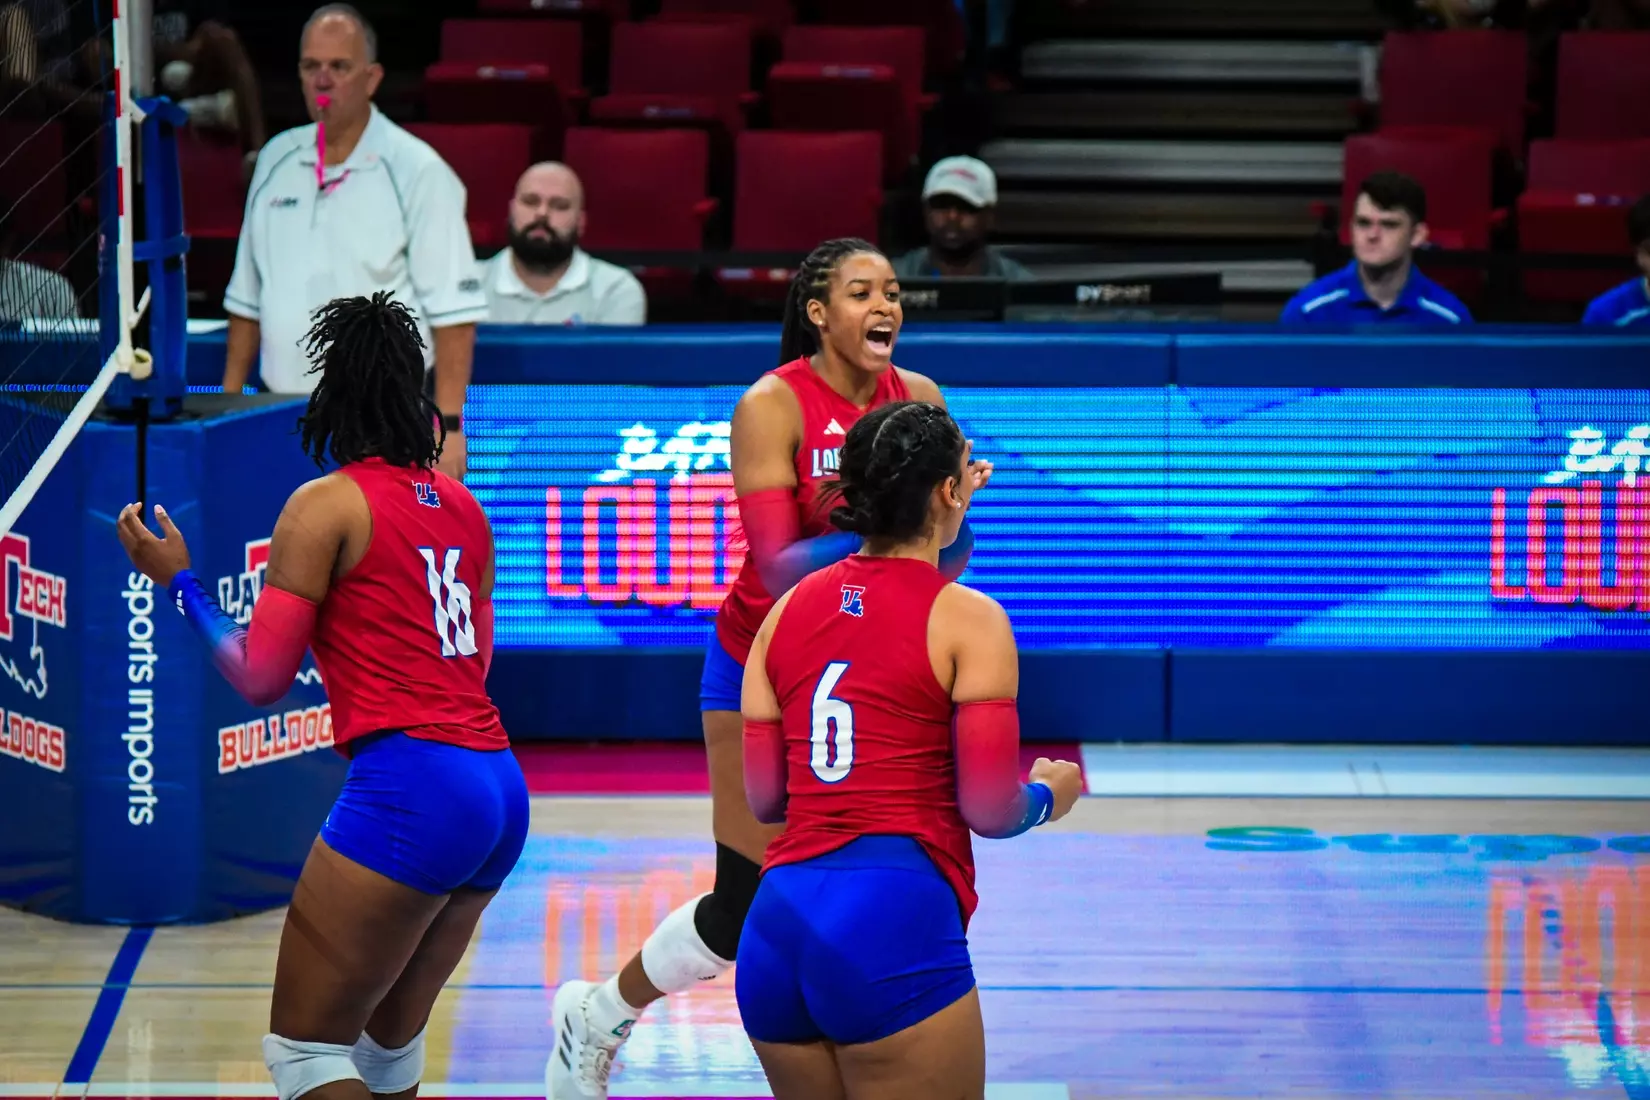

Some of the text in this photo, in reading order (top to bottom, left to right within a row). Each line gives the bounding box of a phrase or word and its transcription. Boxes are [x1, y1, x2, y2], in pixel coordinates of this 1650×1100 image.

[546, 474, 742, 609] LOUD
[1490, 480, 1650, 611] LOU
[121, 571, 159, 683] sports
[417, 545, 480, 659] 16
[0, 706, 66, 773] LDOGS
[217, 702, 335, 775] BULLDOG
[810, 659, 854, 785] 6
